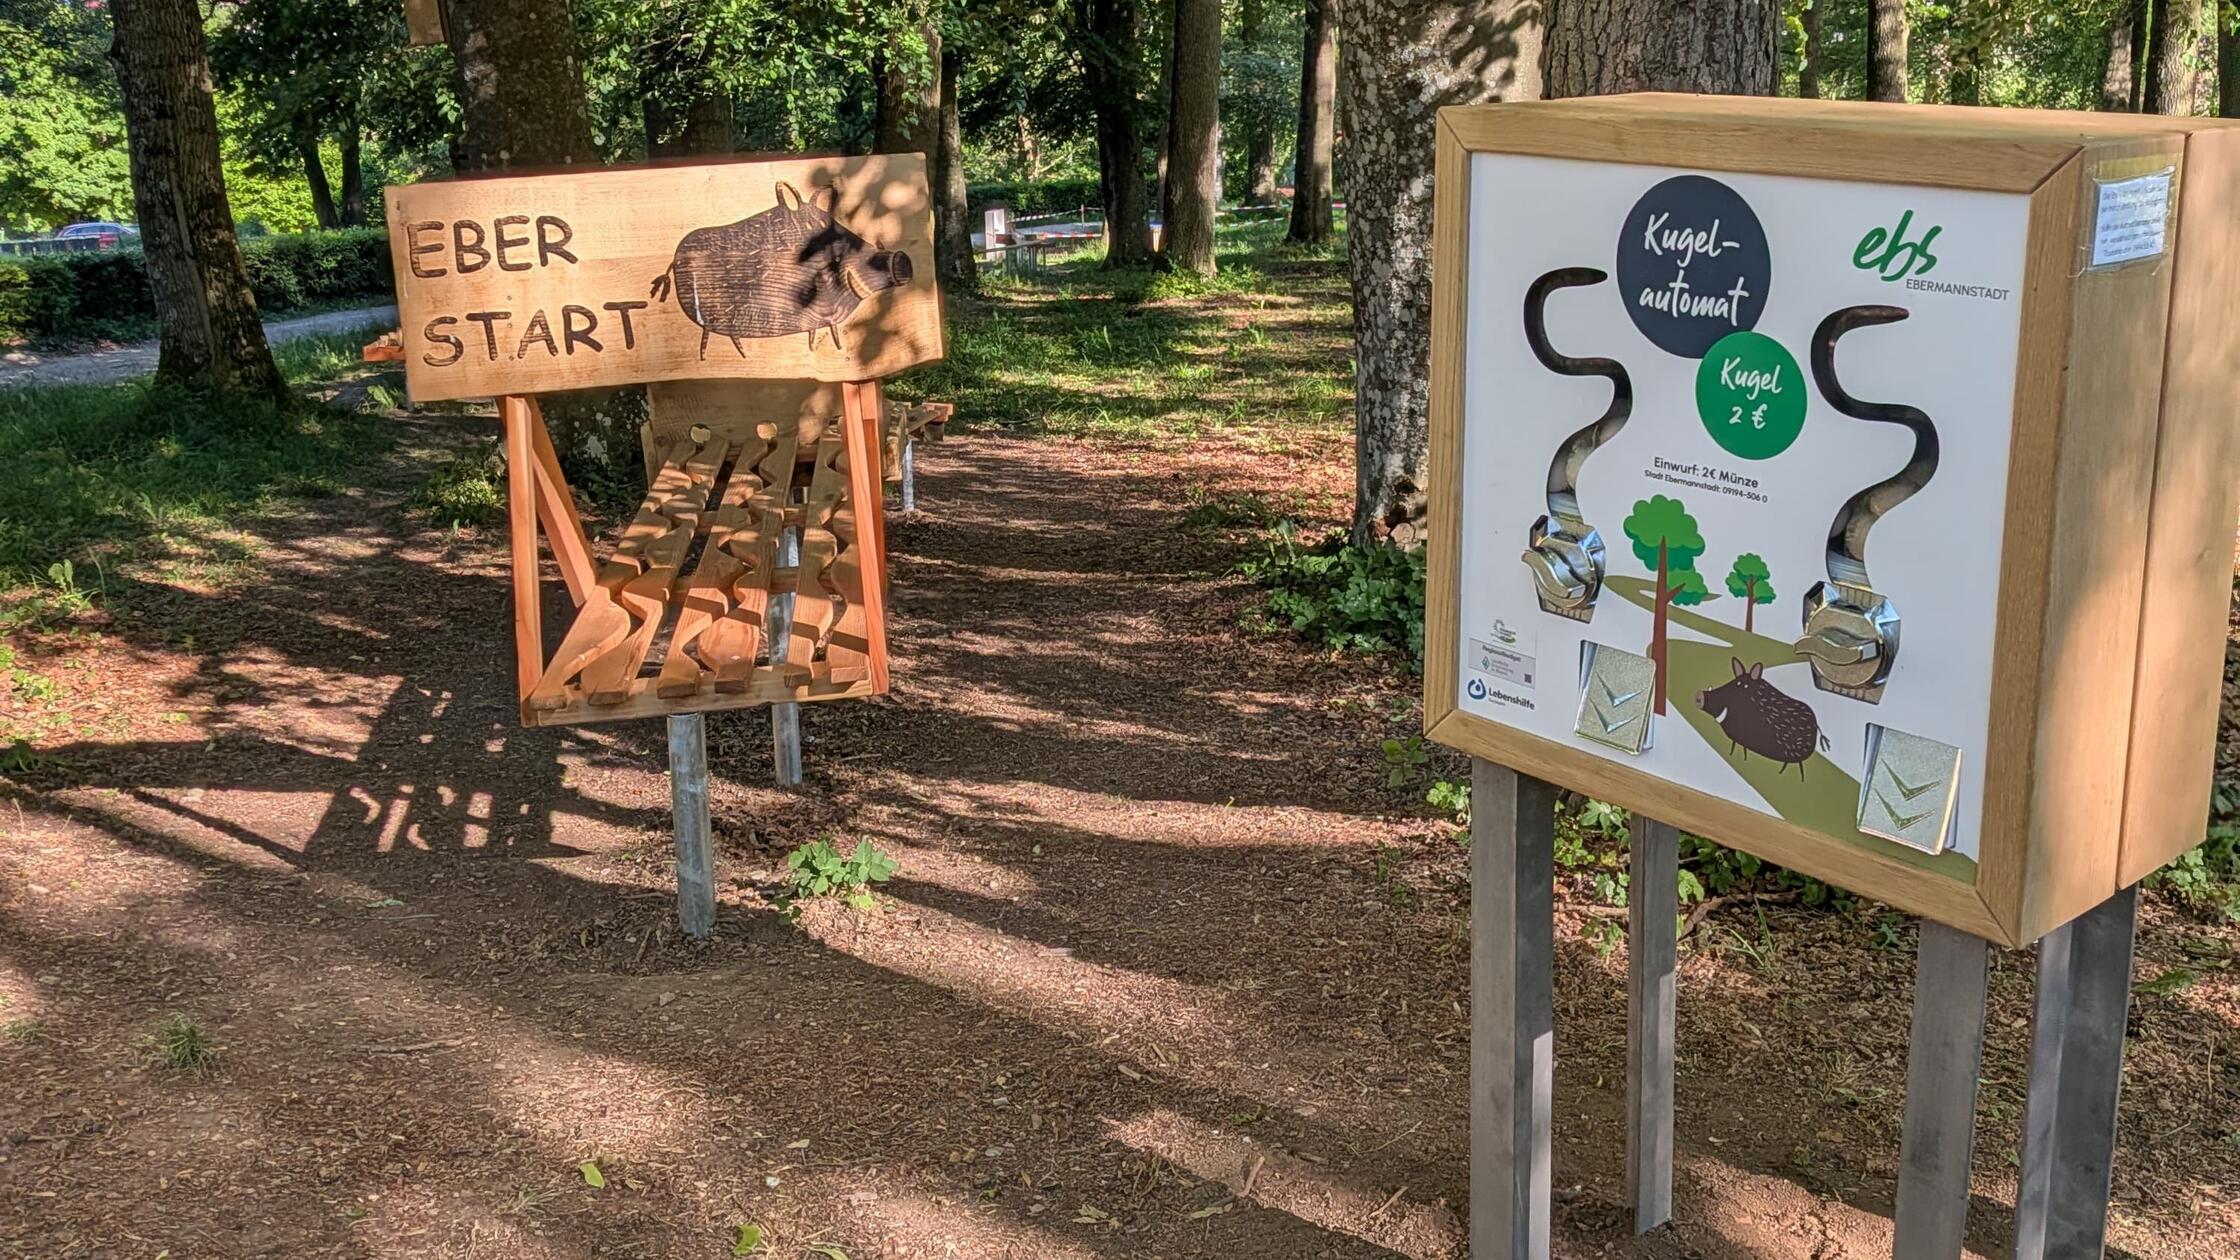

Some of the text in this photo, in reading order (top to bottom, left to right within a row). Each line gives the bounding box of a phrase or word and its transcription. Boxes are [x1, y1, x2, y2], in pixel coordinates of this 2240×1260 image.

[407, 215, 579, 278] EBER
[1644, 212, 1740, 268] Kugel-
[1852, 209, 1943, 282] ebs
[1639, 269, 1750, 327] automat
[1906, 278, 2010, 301] EBERMANNSTADT
[423, 301, 648, 367] START
[1720, 357, 1782, 401] Kugel
[1729, 403, 1767, 429] 2 €
[1643, 469, 1664, 481] Stadt
[1653, 456, 1759, 488] Einwurf: 2€ Münze
[1488, 687, 1535, 710] Lebenshilfe
